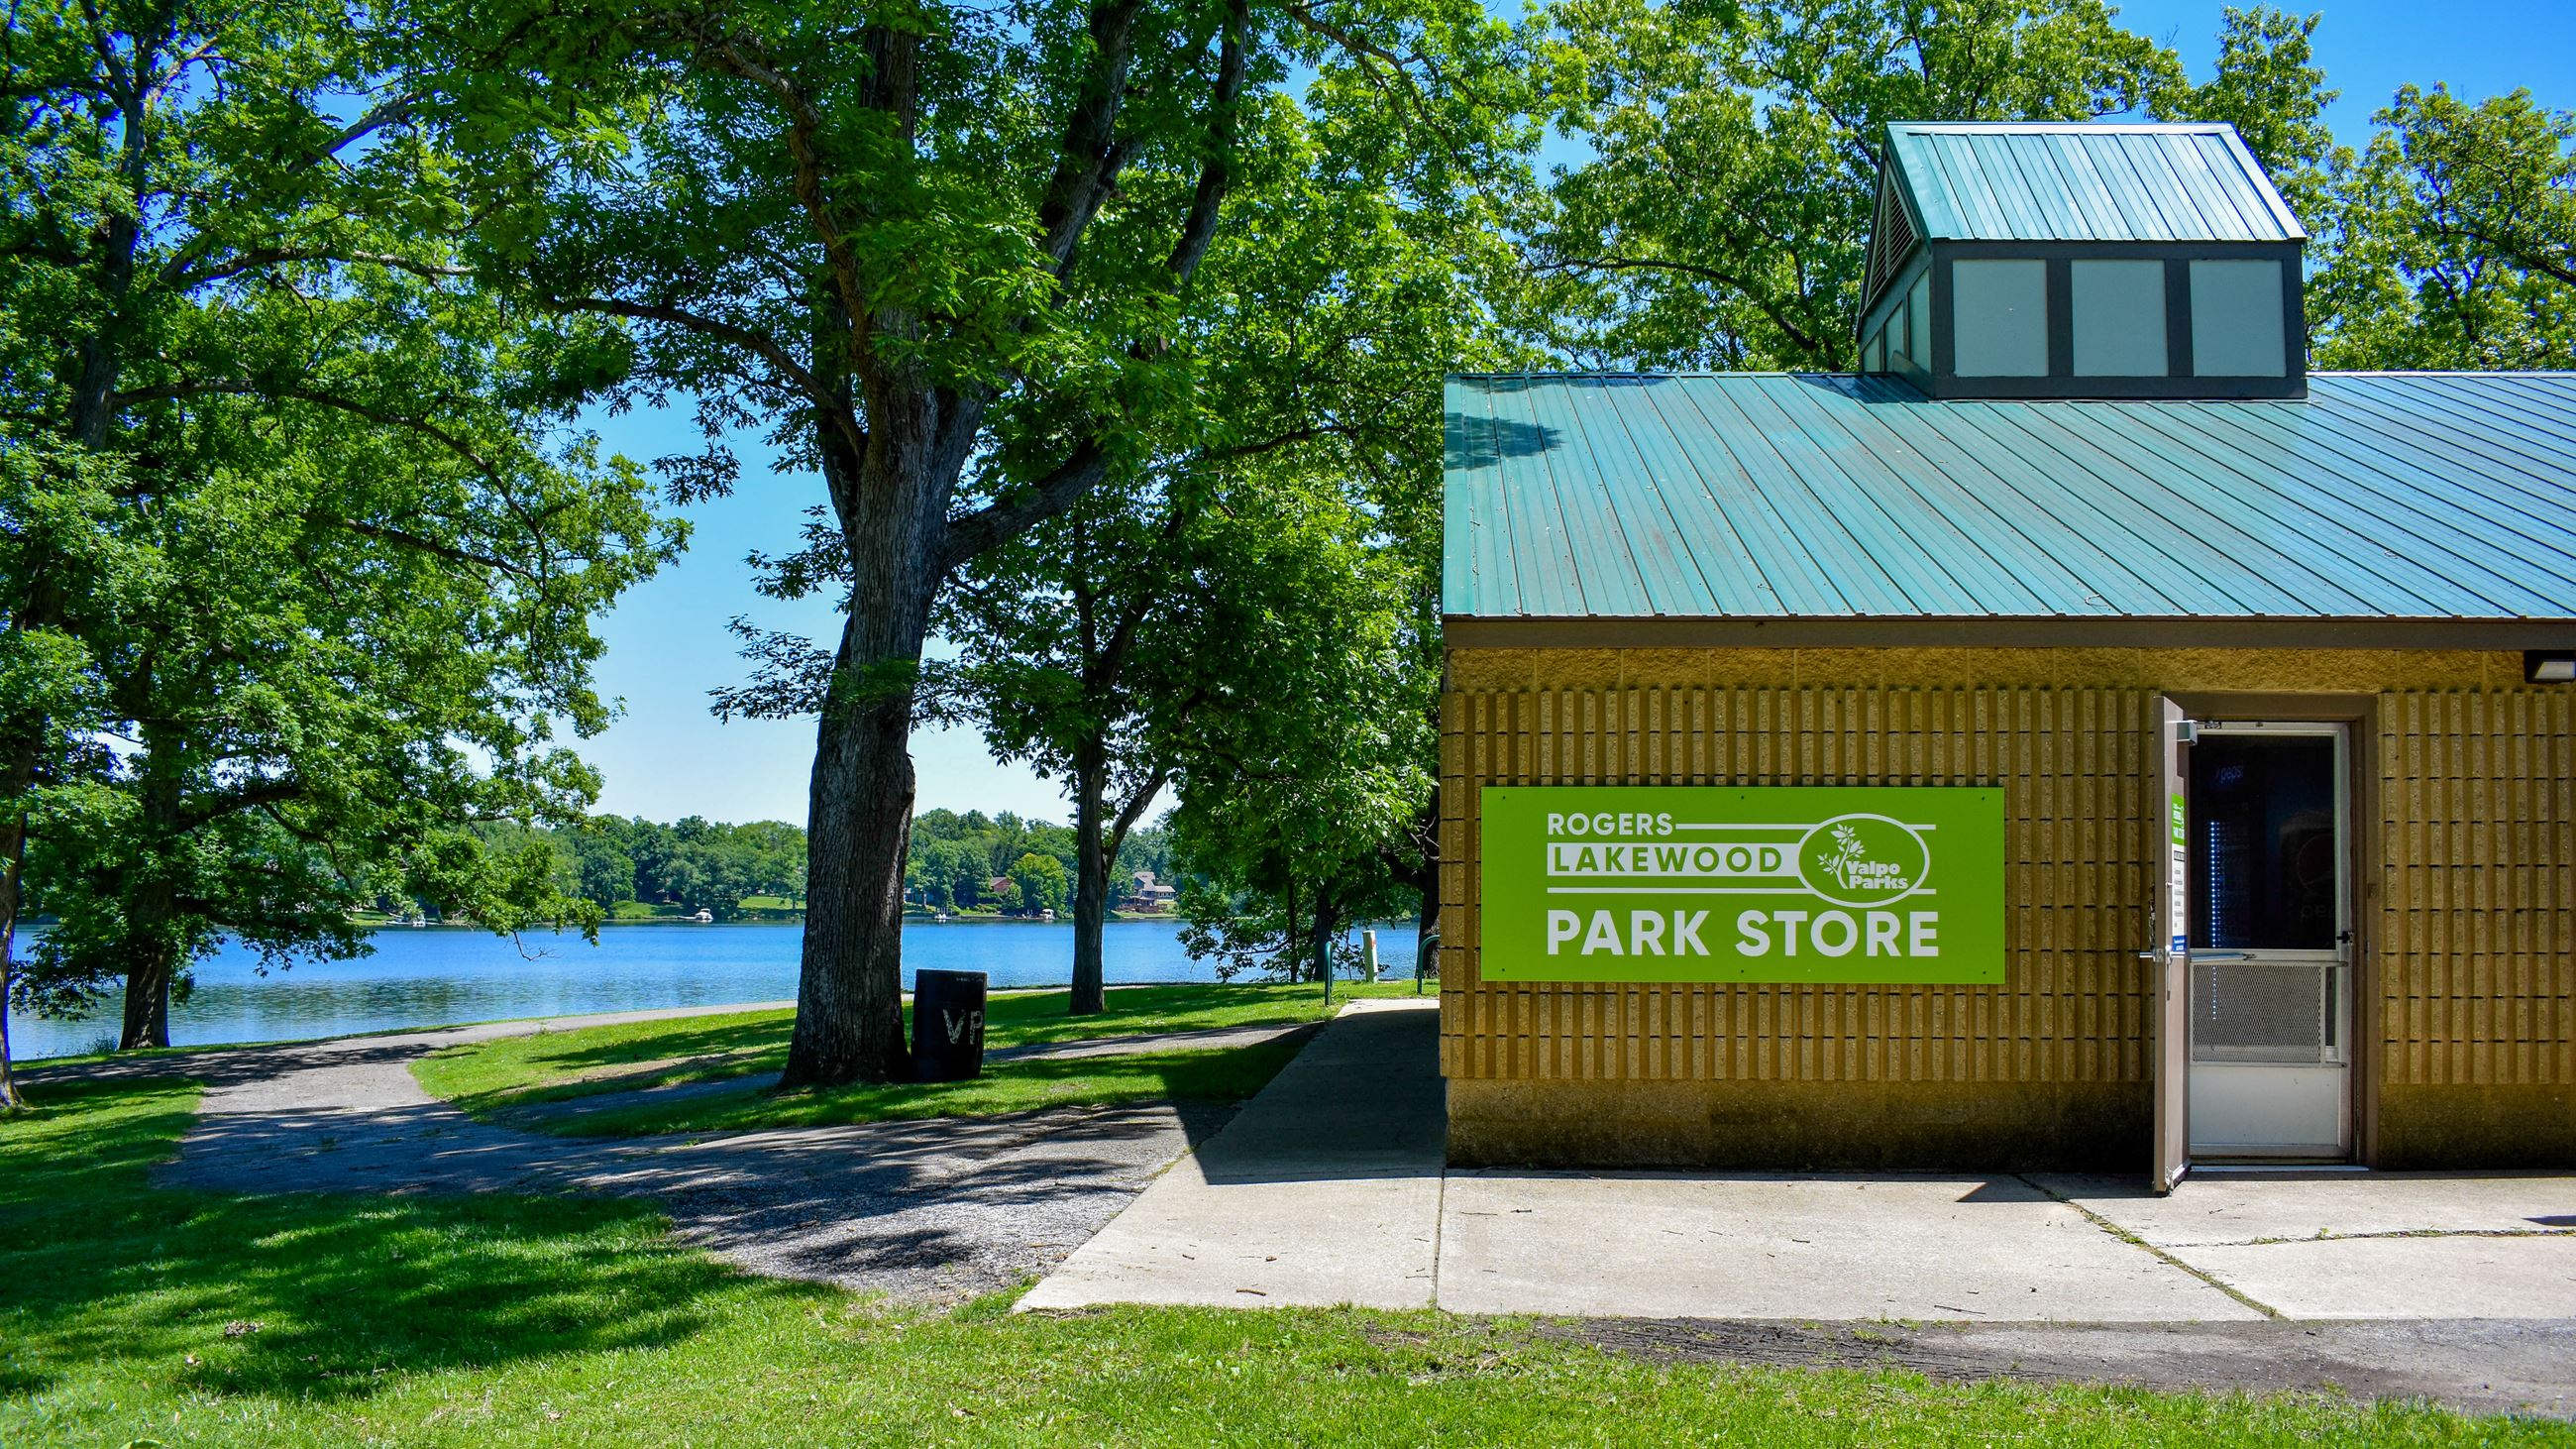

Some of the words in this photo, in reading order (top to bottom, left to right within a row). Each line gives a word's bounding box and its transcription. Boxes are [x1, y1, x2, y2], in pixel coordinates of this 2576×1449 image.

[1548, 813, 1673, 836] ROGERS
[1554, 846, 1782, 872] LAKEWOOD
[1846, 860, 1901, 875] Valpo
[1849, 875, 1909, 890] Parks
[1547, 910, 1711, 955] PARK
[1735, 909, 1940, 957] STORE
[942, 1009, 983, 1046] VP
